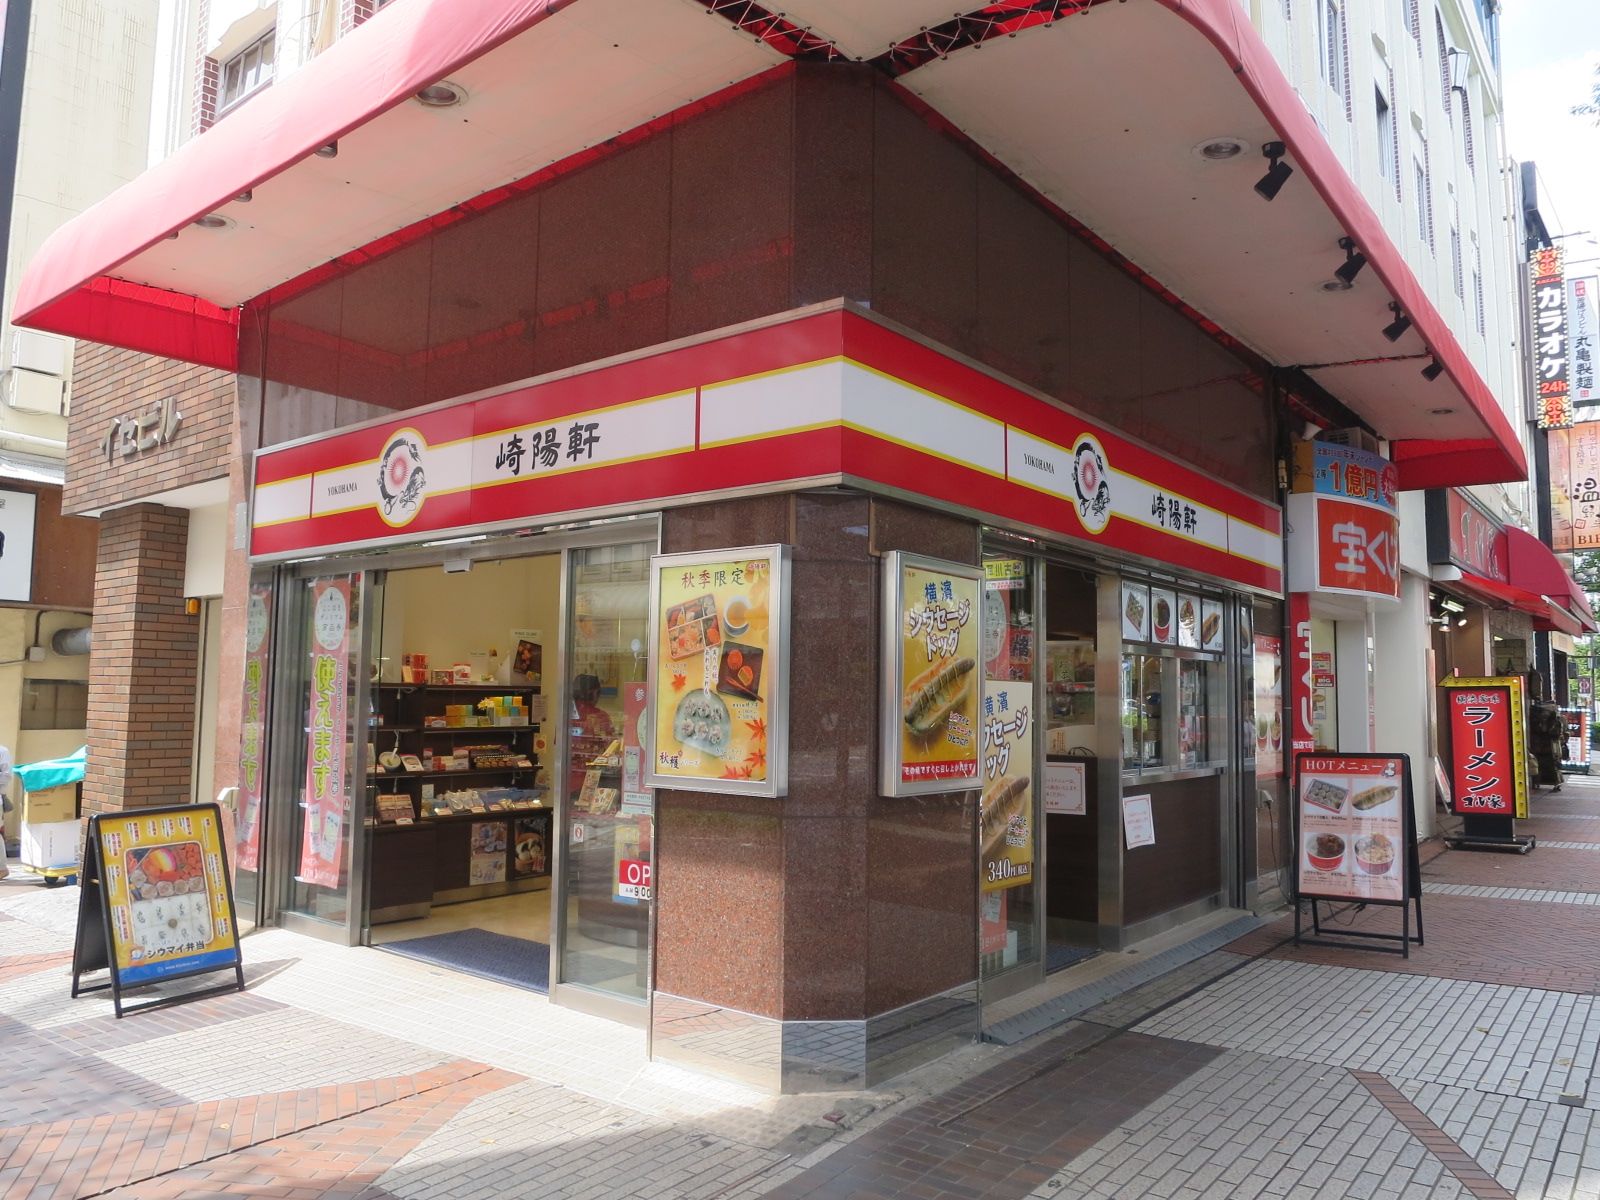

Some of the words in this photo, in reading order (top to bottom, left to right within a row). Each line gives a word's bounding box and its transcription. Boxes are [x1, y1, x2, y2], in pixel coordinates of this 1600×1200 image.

[1537, 286, 1563, 378] カラオケ
[1541, 381, 1567, 393] 24h
[495, 421, 600, 476] 崎陽軒
[1023, 452, 1055, 474] YOKOHAMA
[327, 480, 359, 497] YOKOHAMA
[1151, 492, 1198, 535] 崎陽軒
[681, 567, 745, 589] 秋季限定
[925, 580, 953, 604] 横濱
[925, 626, 960, 662] ドッグ
[985, 691, 1008, 717] 横濱
[1462, 706, 1500, 792] ラーメン
[1306, 760, 1383, 770] HOTメニュー
[627, 863, 651, 884] OP
[147, 941, 204, 958] シウマイ弁当
